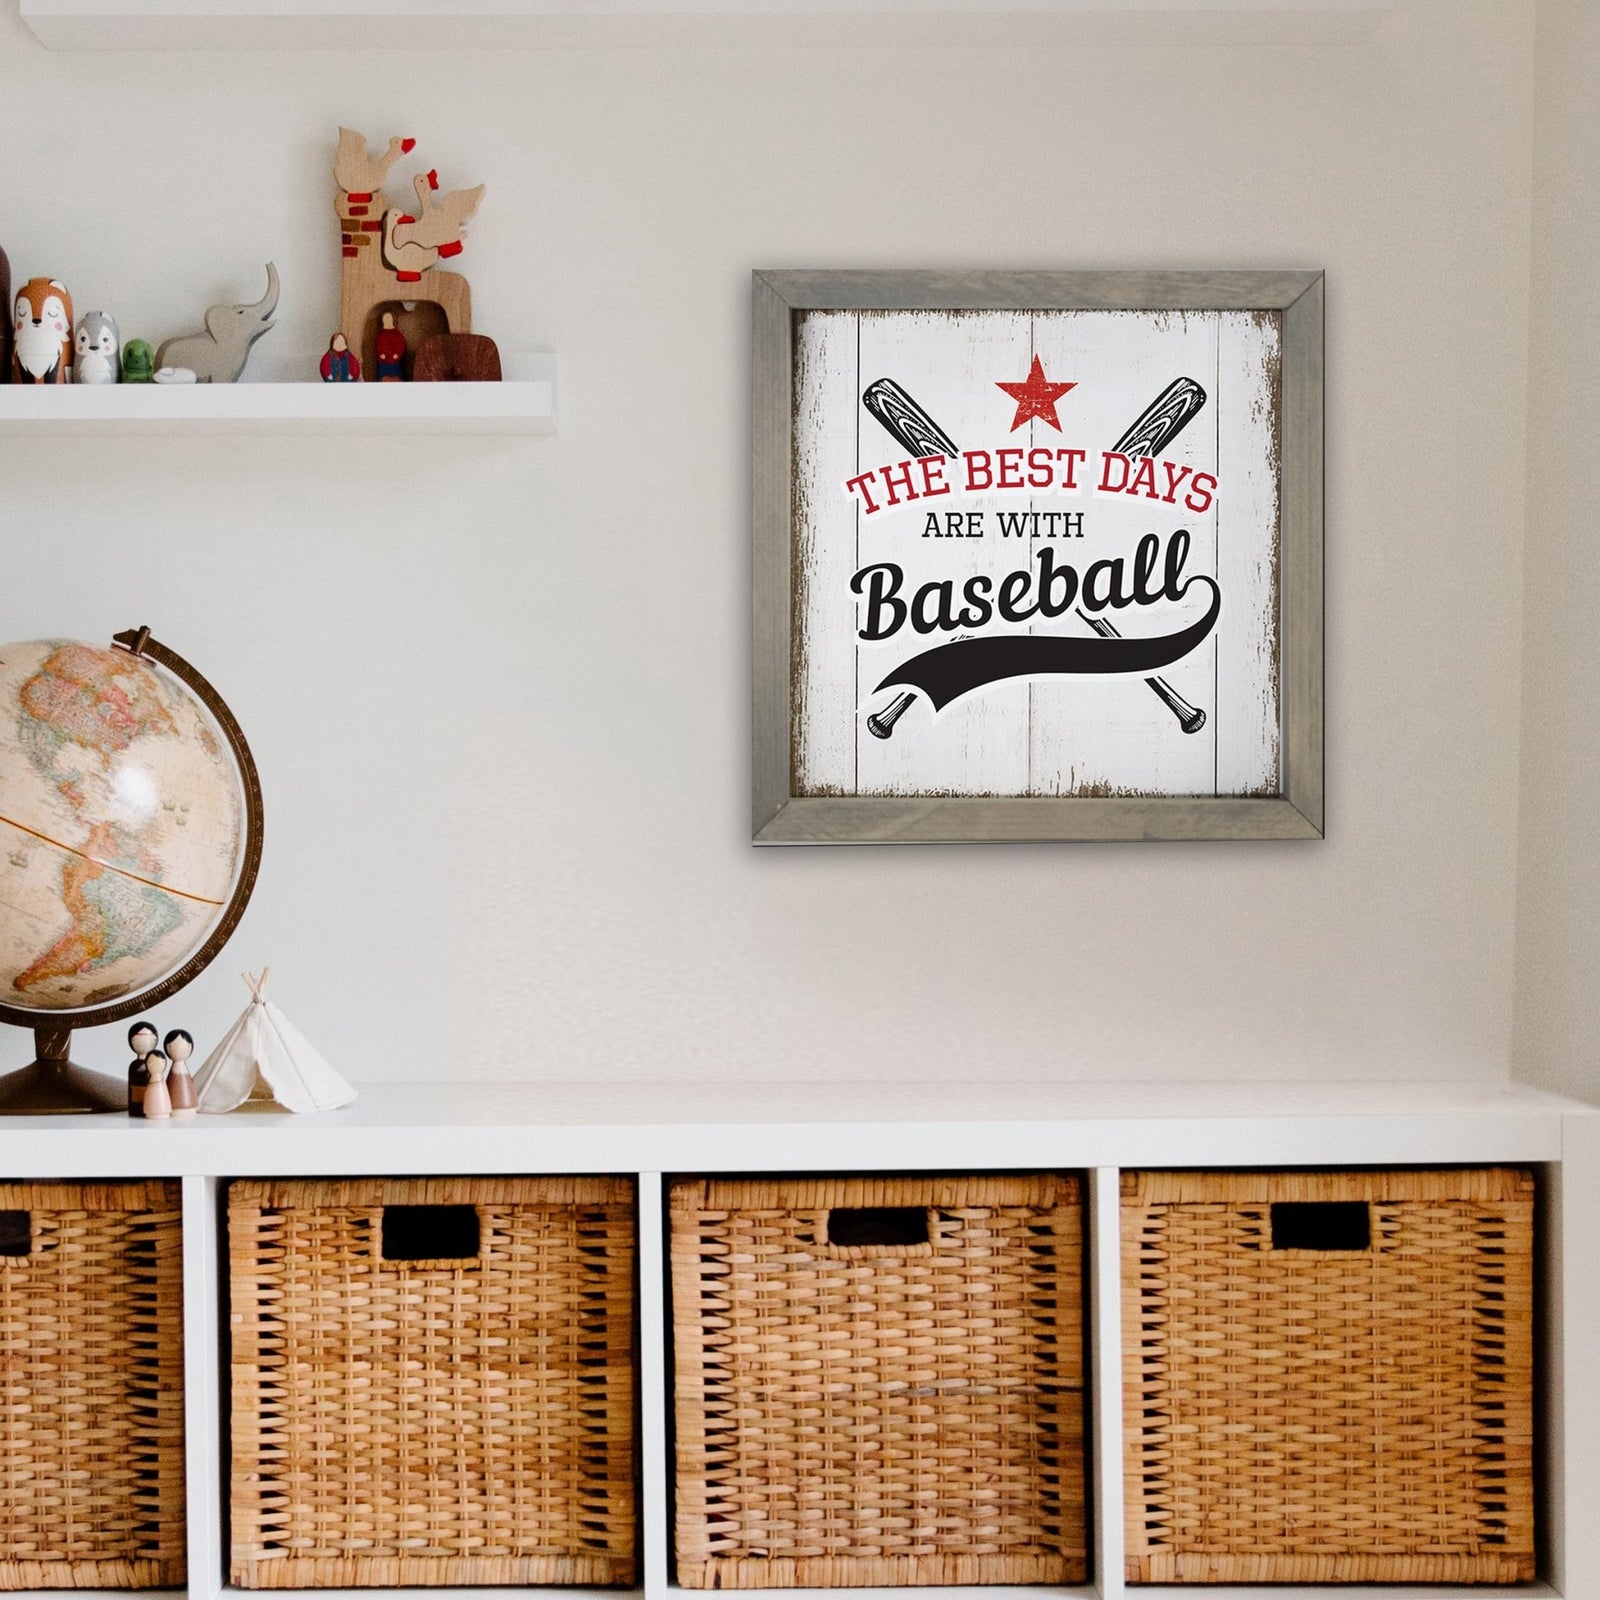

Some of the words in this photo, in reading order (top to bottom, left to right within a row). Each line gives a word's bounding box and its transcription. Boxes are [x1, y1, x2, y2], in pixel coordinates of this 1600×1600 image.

[846, 454, 951, 515] THE
[962, 448, 1086, 491] BEST
[1097, 451, 1218, 513] DAYS
[921, 512, 984, 538] ARE
[996, 512, 1085, 538] WITH
[849, 529, 1206, 642] Baseball
